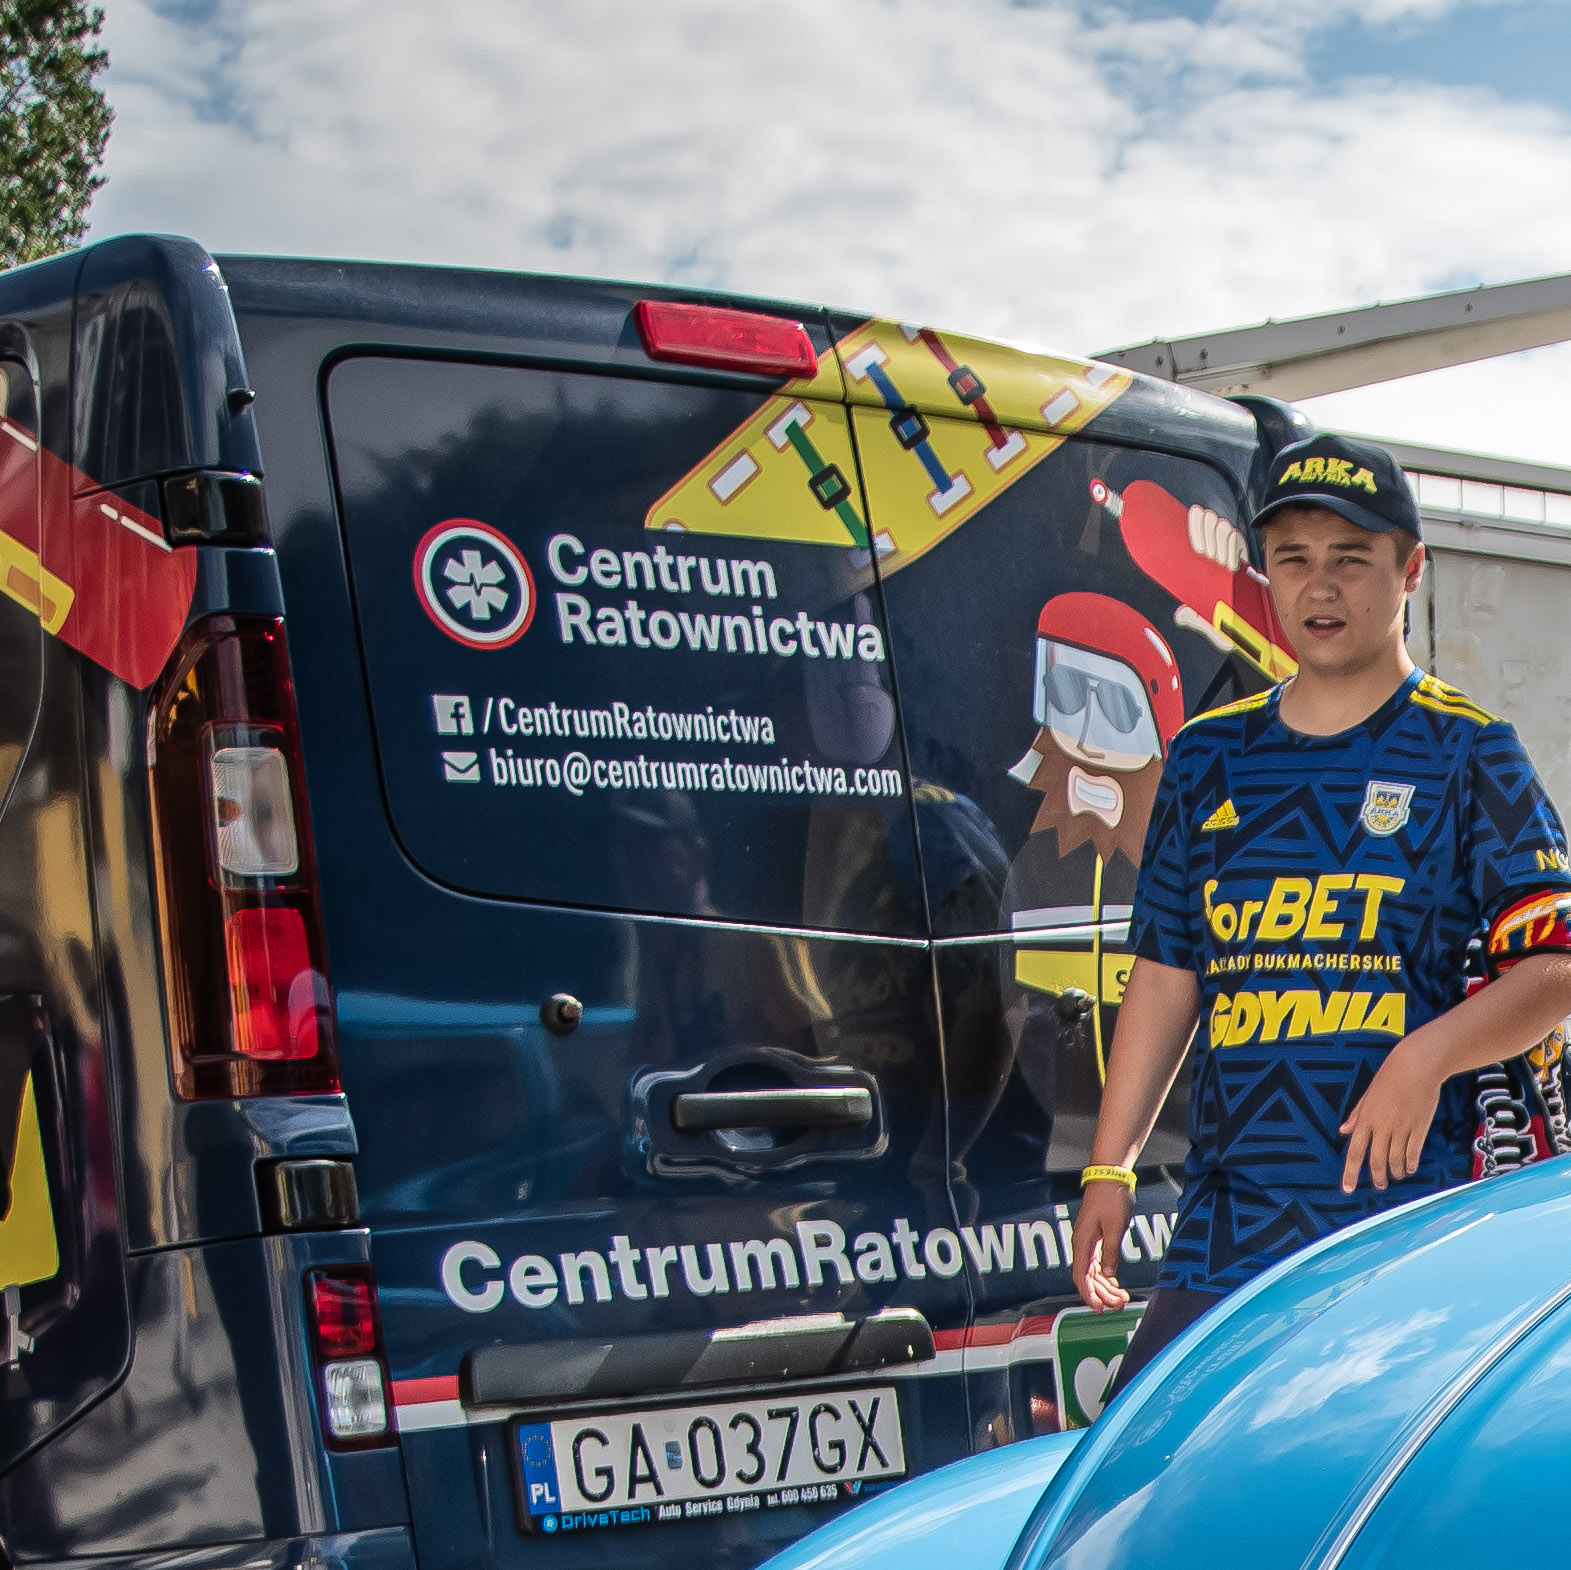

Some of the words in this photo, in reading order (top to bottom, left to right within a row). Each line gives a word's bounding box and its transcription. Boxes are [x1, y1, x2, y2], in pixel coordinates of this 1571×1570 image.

[1279, 457, 1378, 495] ARKA
[548, 534, 778, 600] Centrum
[555, 592, 886, 662] Ratownictwa
[489, 748, 903, 796] biuro@centrumratownictwa.com
[1204, 873, 1405, 943] forBET
[1254, 953, 1402, 971] BUKMACHERSKIE
[1210, 990, 1406, 1050] GDYNIA
[441, 1205, 1180, 1313] CentrumRatownitw
[571, 1422, 665, 1504] GA
[686, 1396, 890, 1490] 037GX
[530, 1481, 557, 1507] PL
[561, 1506, 652, 1530] DriveTech
[658, 1503, 682, 1521] Auto
[685, 1499, 723, 1518] Service
[726, 1493, 760, 1512] Gdynia
[801, 1486, 818, 1502] 450
